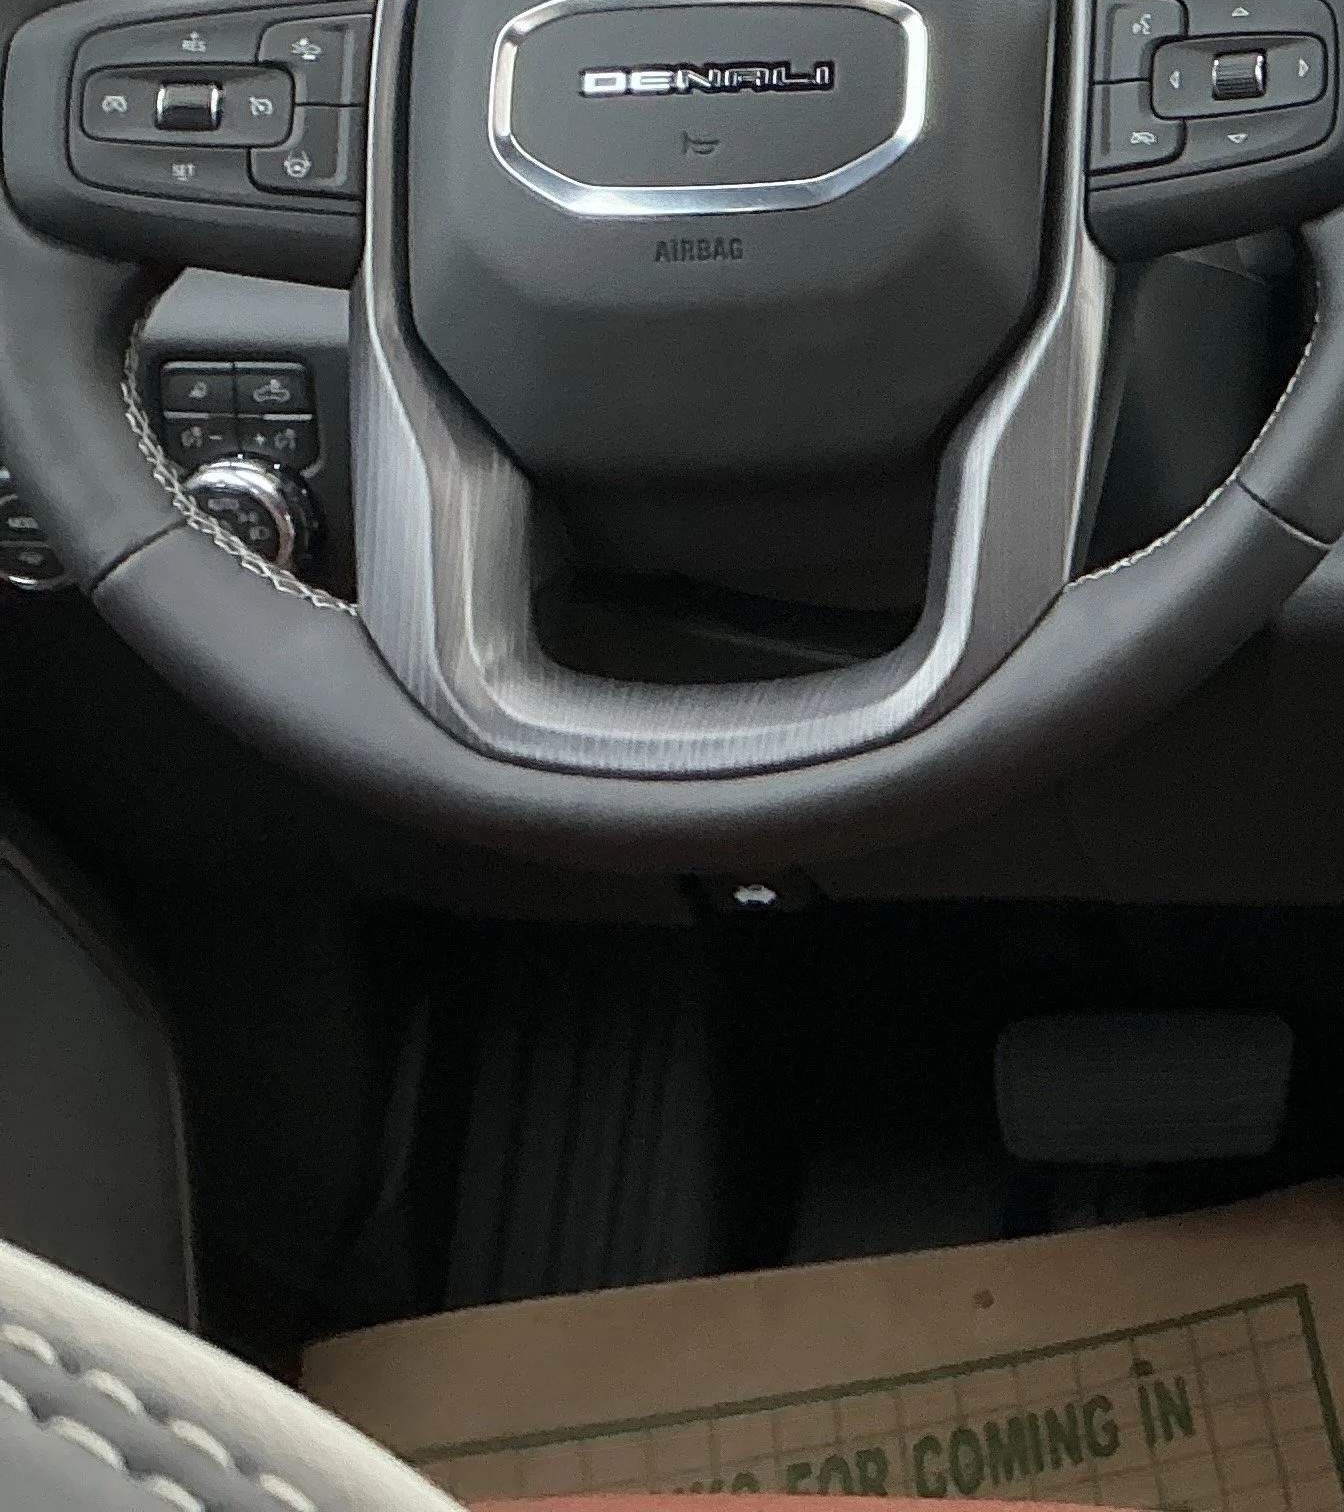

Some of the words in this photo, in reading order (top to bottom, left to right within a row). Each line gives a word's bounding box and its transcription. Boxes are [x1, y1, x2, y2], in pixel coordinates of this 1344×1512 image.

[583, 65, 830, 93] DENALI
[654, 237, 744, 263] AIRBAG
[913, 1394, 1121, 1499] COMING
[1137, 1374, 1196, 1449] IN
